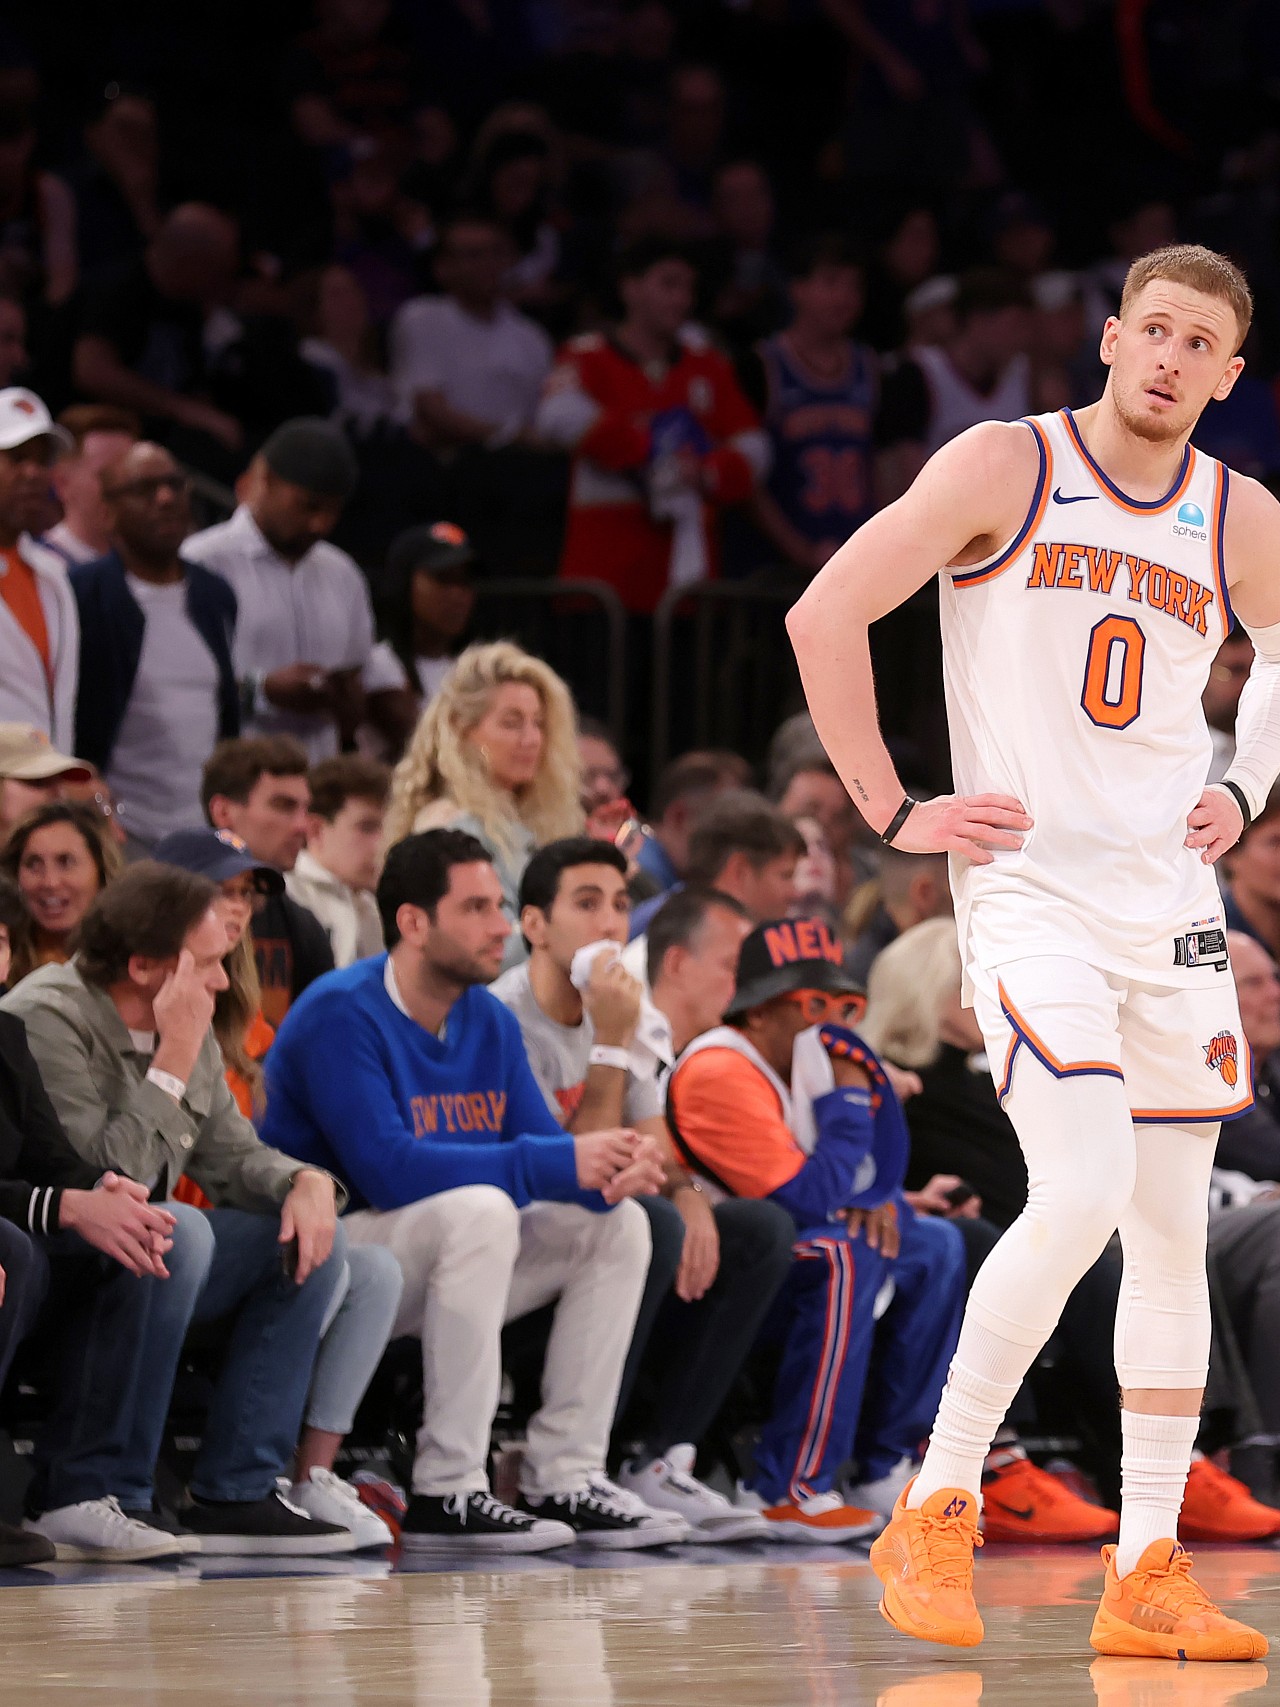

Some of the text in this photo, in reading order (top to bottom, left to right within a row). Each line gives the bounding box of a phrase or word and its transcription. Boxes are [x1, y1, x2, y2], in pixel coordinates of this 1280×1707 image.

[1172, 525, 1207, 541] sphere
[1026, 543, 1214, 639] NEW YORK
[1080, 613, 1147, 730] 0
